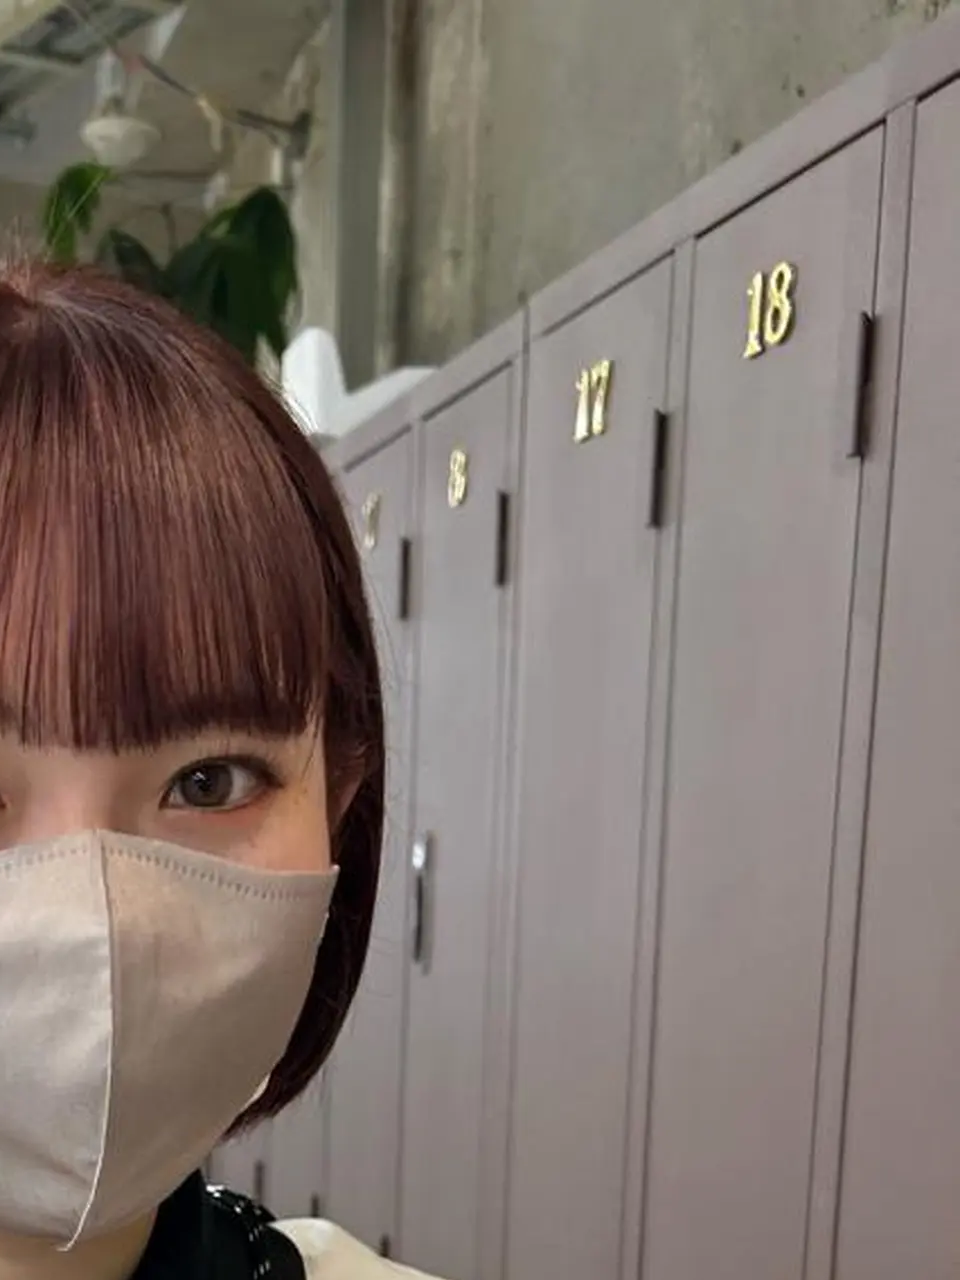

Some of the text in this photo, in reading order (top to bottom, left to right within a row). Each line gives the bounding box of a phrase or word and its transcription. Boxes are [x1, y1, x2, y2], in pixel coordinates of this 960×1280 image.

[743, 260, 798, 359] 18
[573, 359, 614, 444] 17
[447, 449, 468, 509] 8
